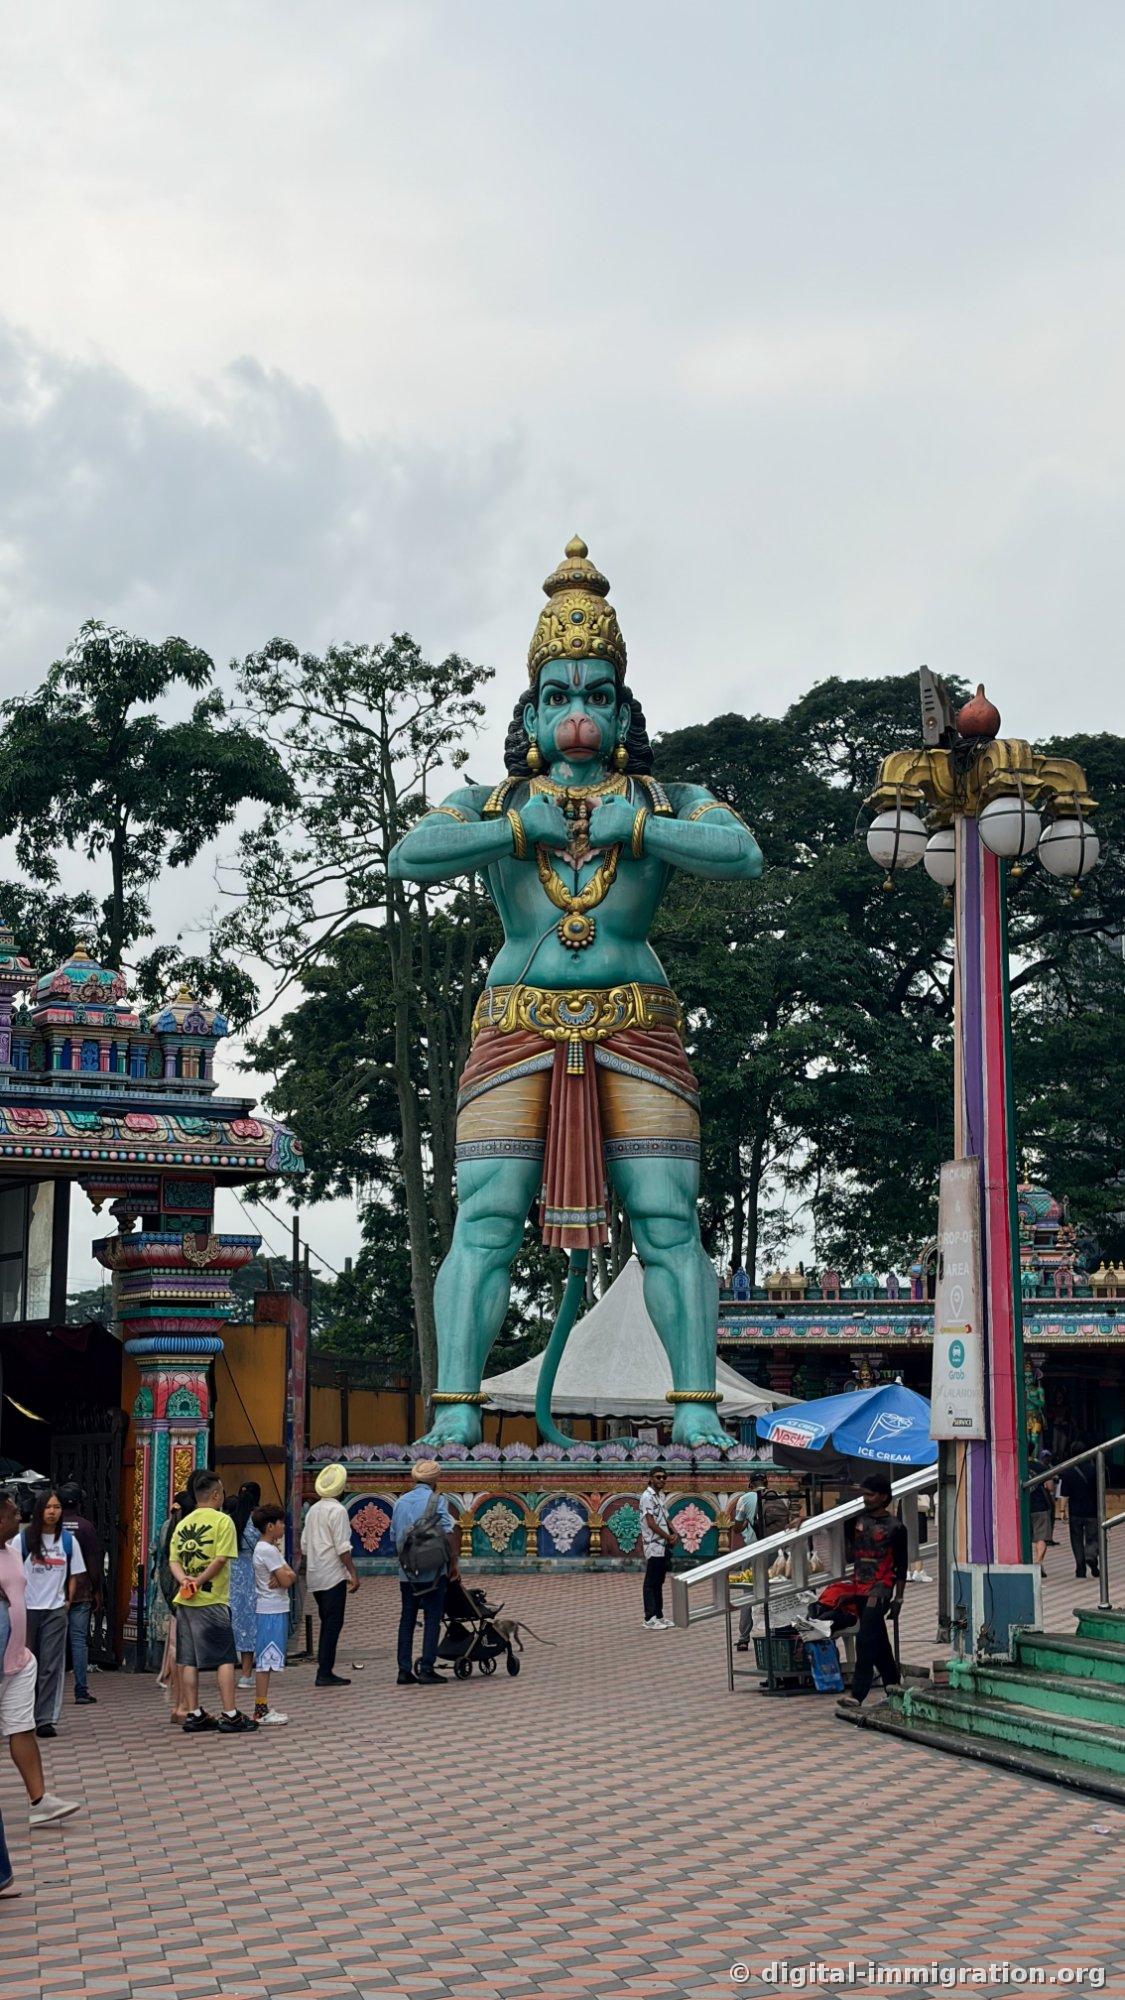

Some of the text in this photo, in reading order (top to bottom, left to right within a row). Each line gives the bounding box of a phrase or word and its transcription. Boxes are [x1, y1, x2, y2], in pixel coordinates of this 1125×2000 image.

[947, 1262, 970, 1276] AREA
[948, 1369, 965, 1380] Grab
[858, 1446, 912, 1461] ICE CREAM
